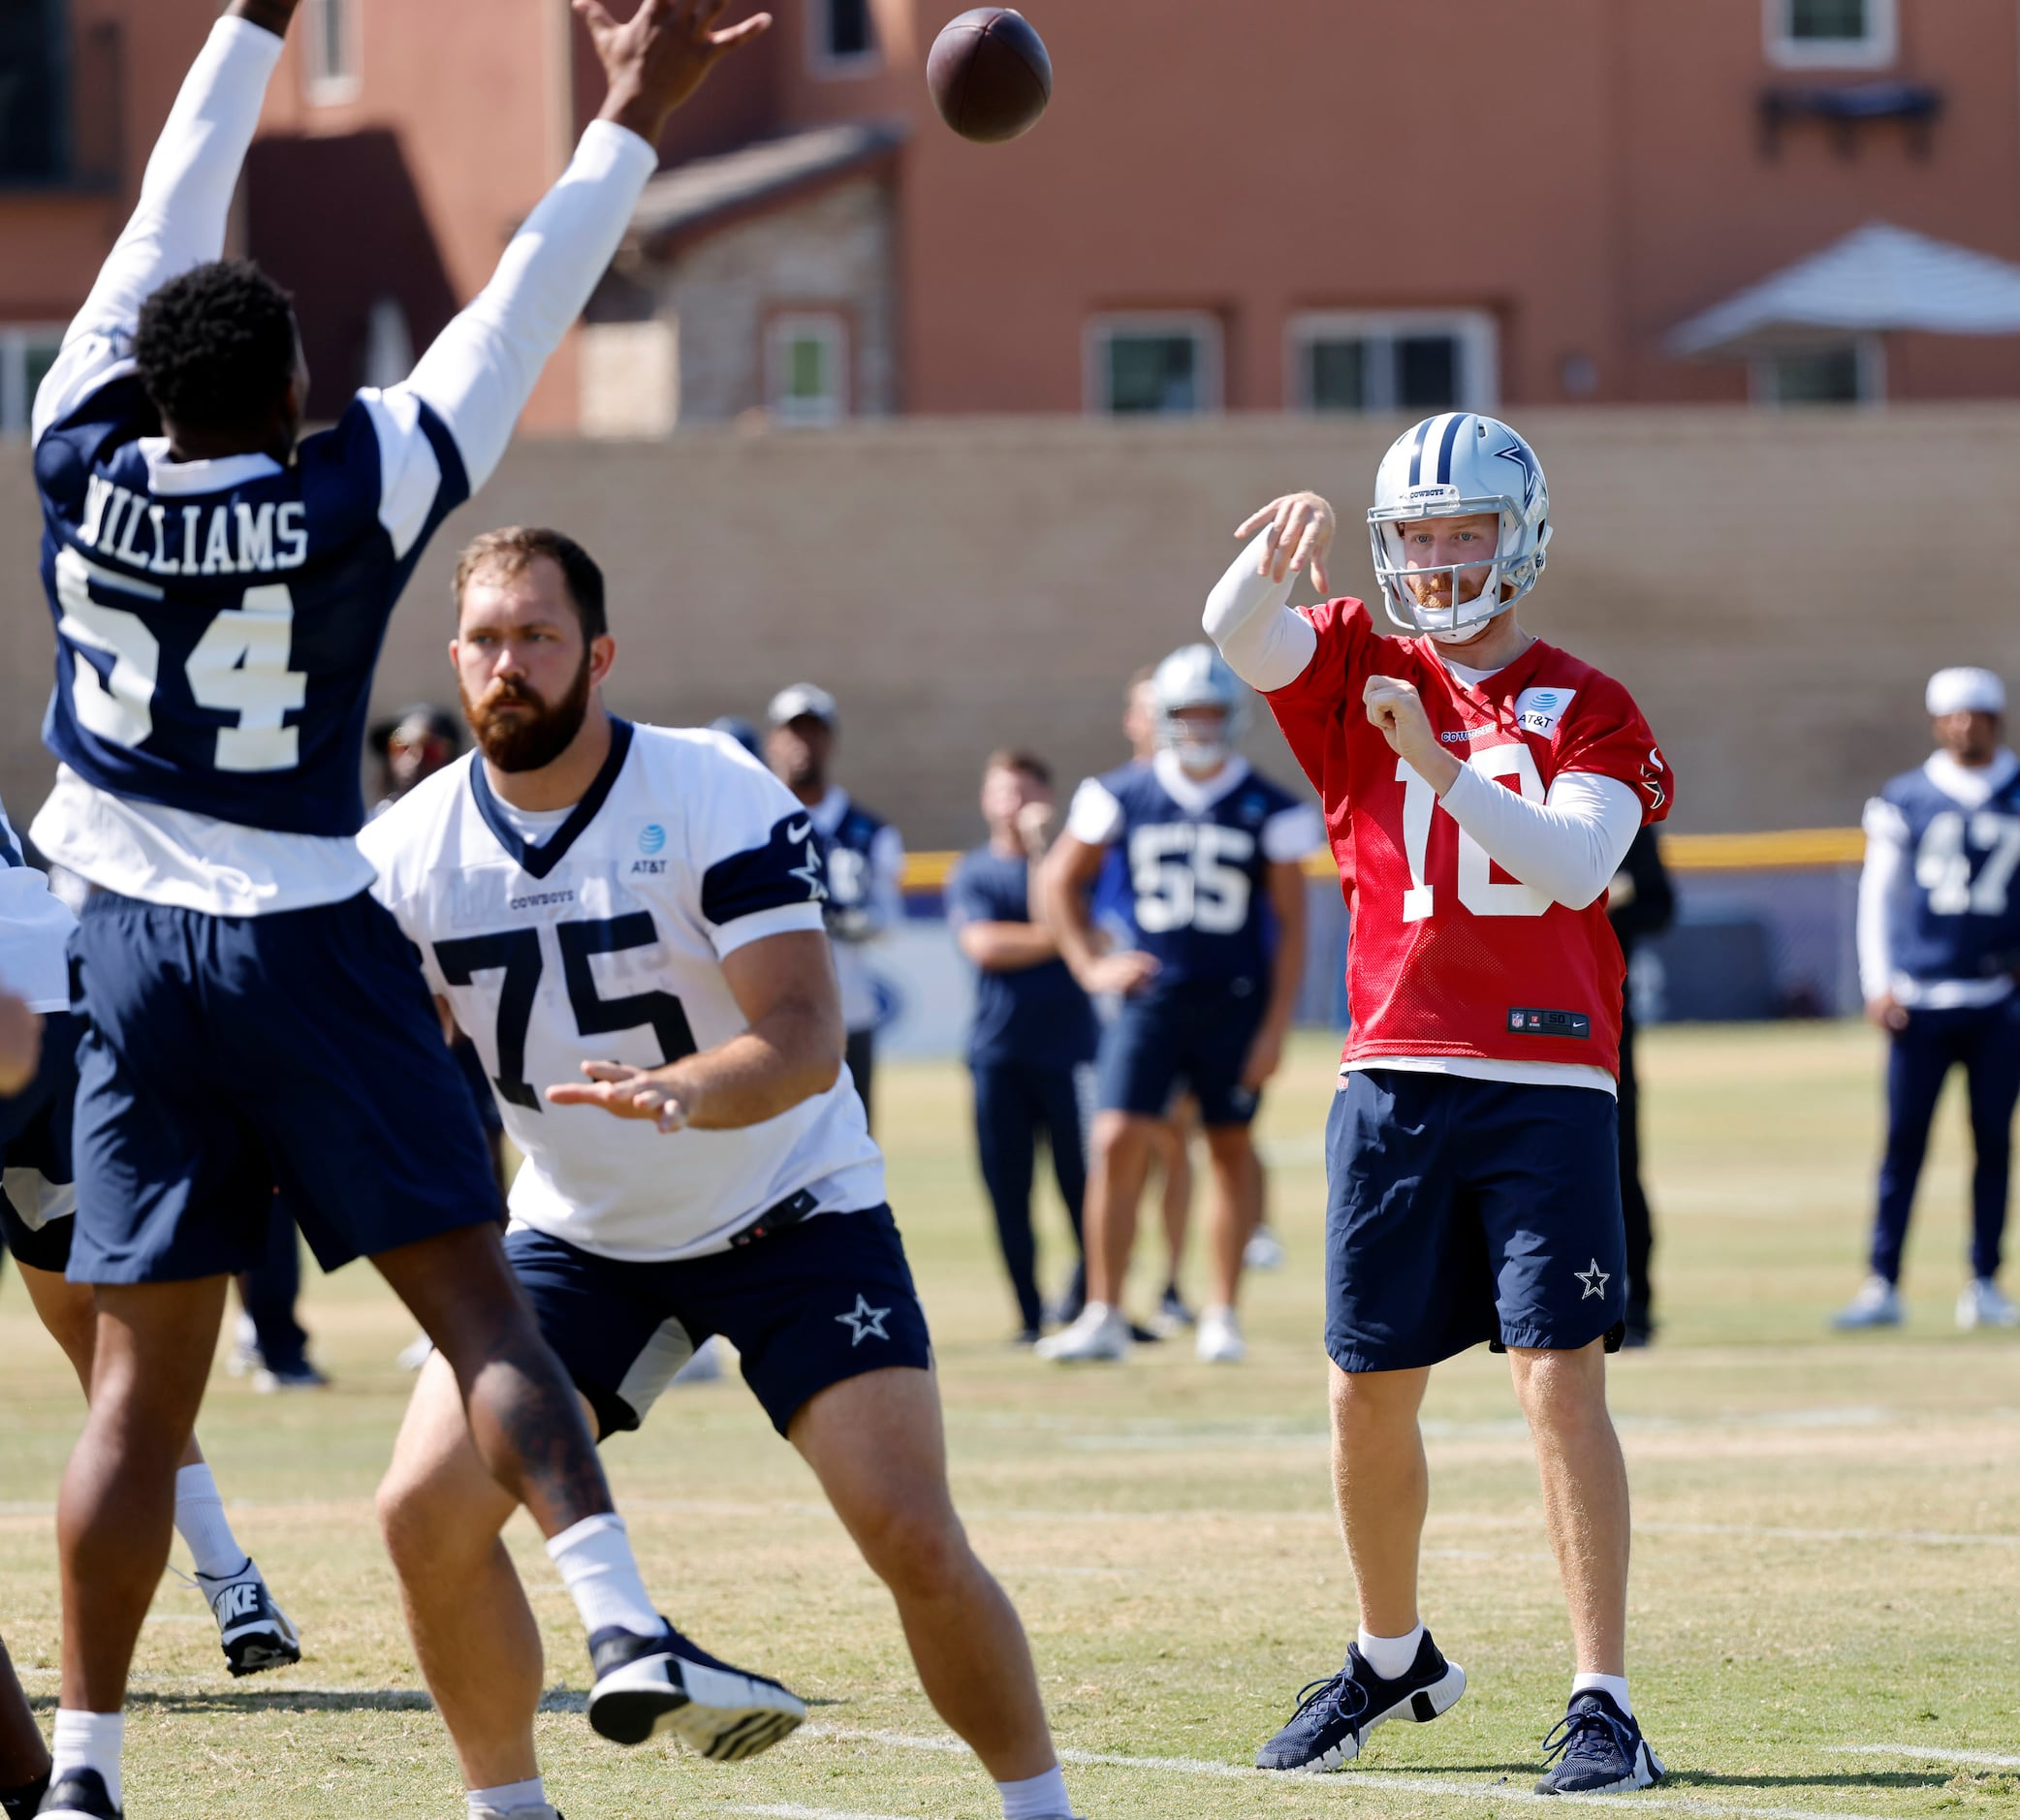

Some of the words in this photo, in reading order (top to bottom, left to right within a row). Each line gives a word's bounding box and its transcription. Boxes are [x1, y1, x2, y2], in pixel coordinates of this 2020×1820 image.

[77, 473, 309, 576] WILLIAMS
[55, 543, 308, 772] 54
[1517, 714, 1554, 729] AT&T
[510, 890, 575, 910] COWBOYS
[631, 860, 668, 874] AT&T
[1127, 822, 1257, 935] 55
[1915, 810, 2020, 916] 47
[432, 910, 698, 1114] 75
